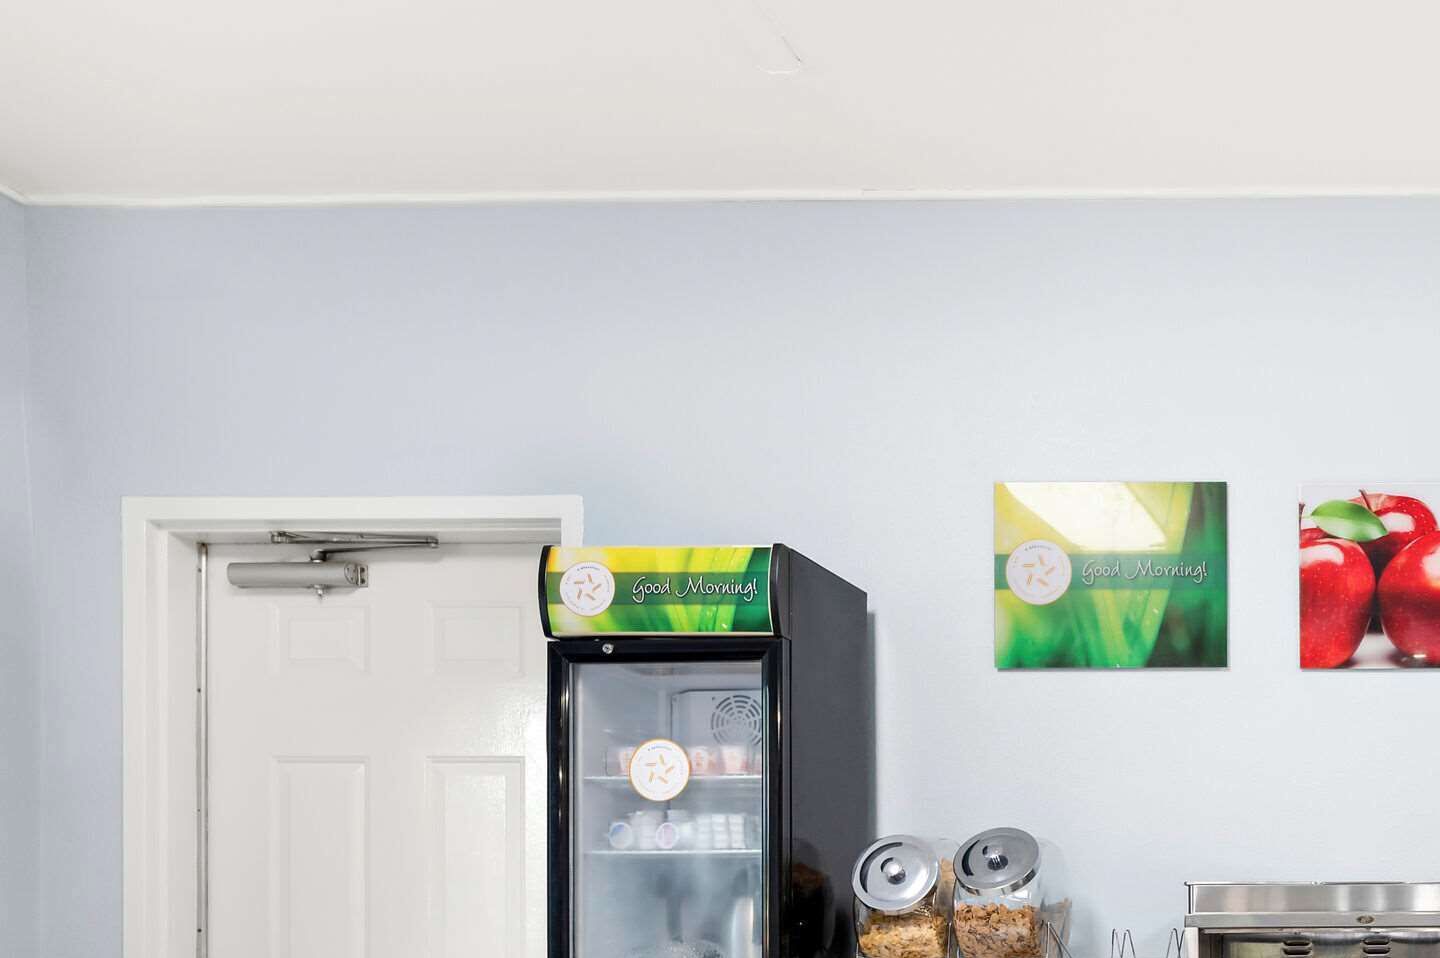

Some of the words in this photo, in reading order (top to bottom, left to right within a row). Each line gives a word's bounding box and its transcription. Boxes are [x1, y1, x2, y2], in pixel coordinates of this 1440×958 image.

[1082, 560, 1121, 584] Good
[1124, 560, 1207, 584] Morning!
[632, 576, 671, 603] Good
[675, 577, 758, 602] Morning!
